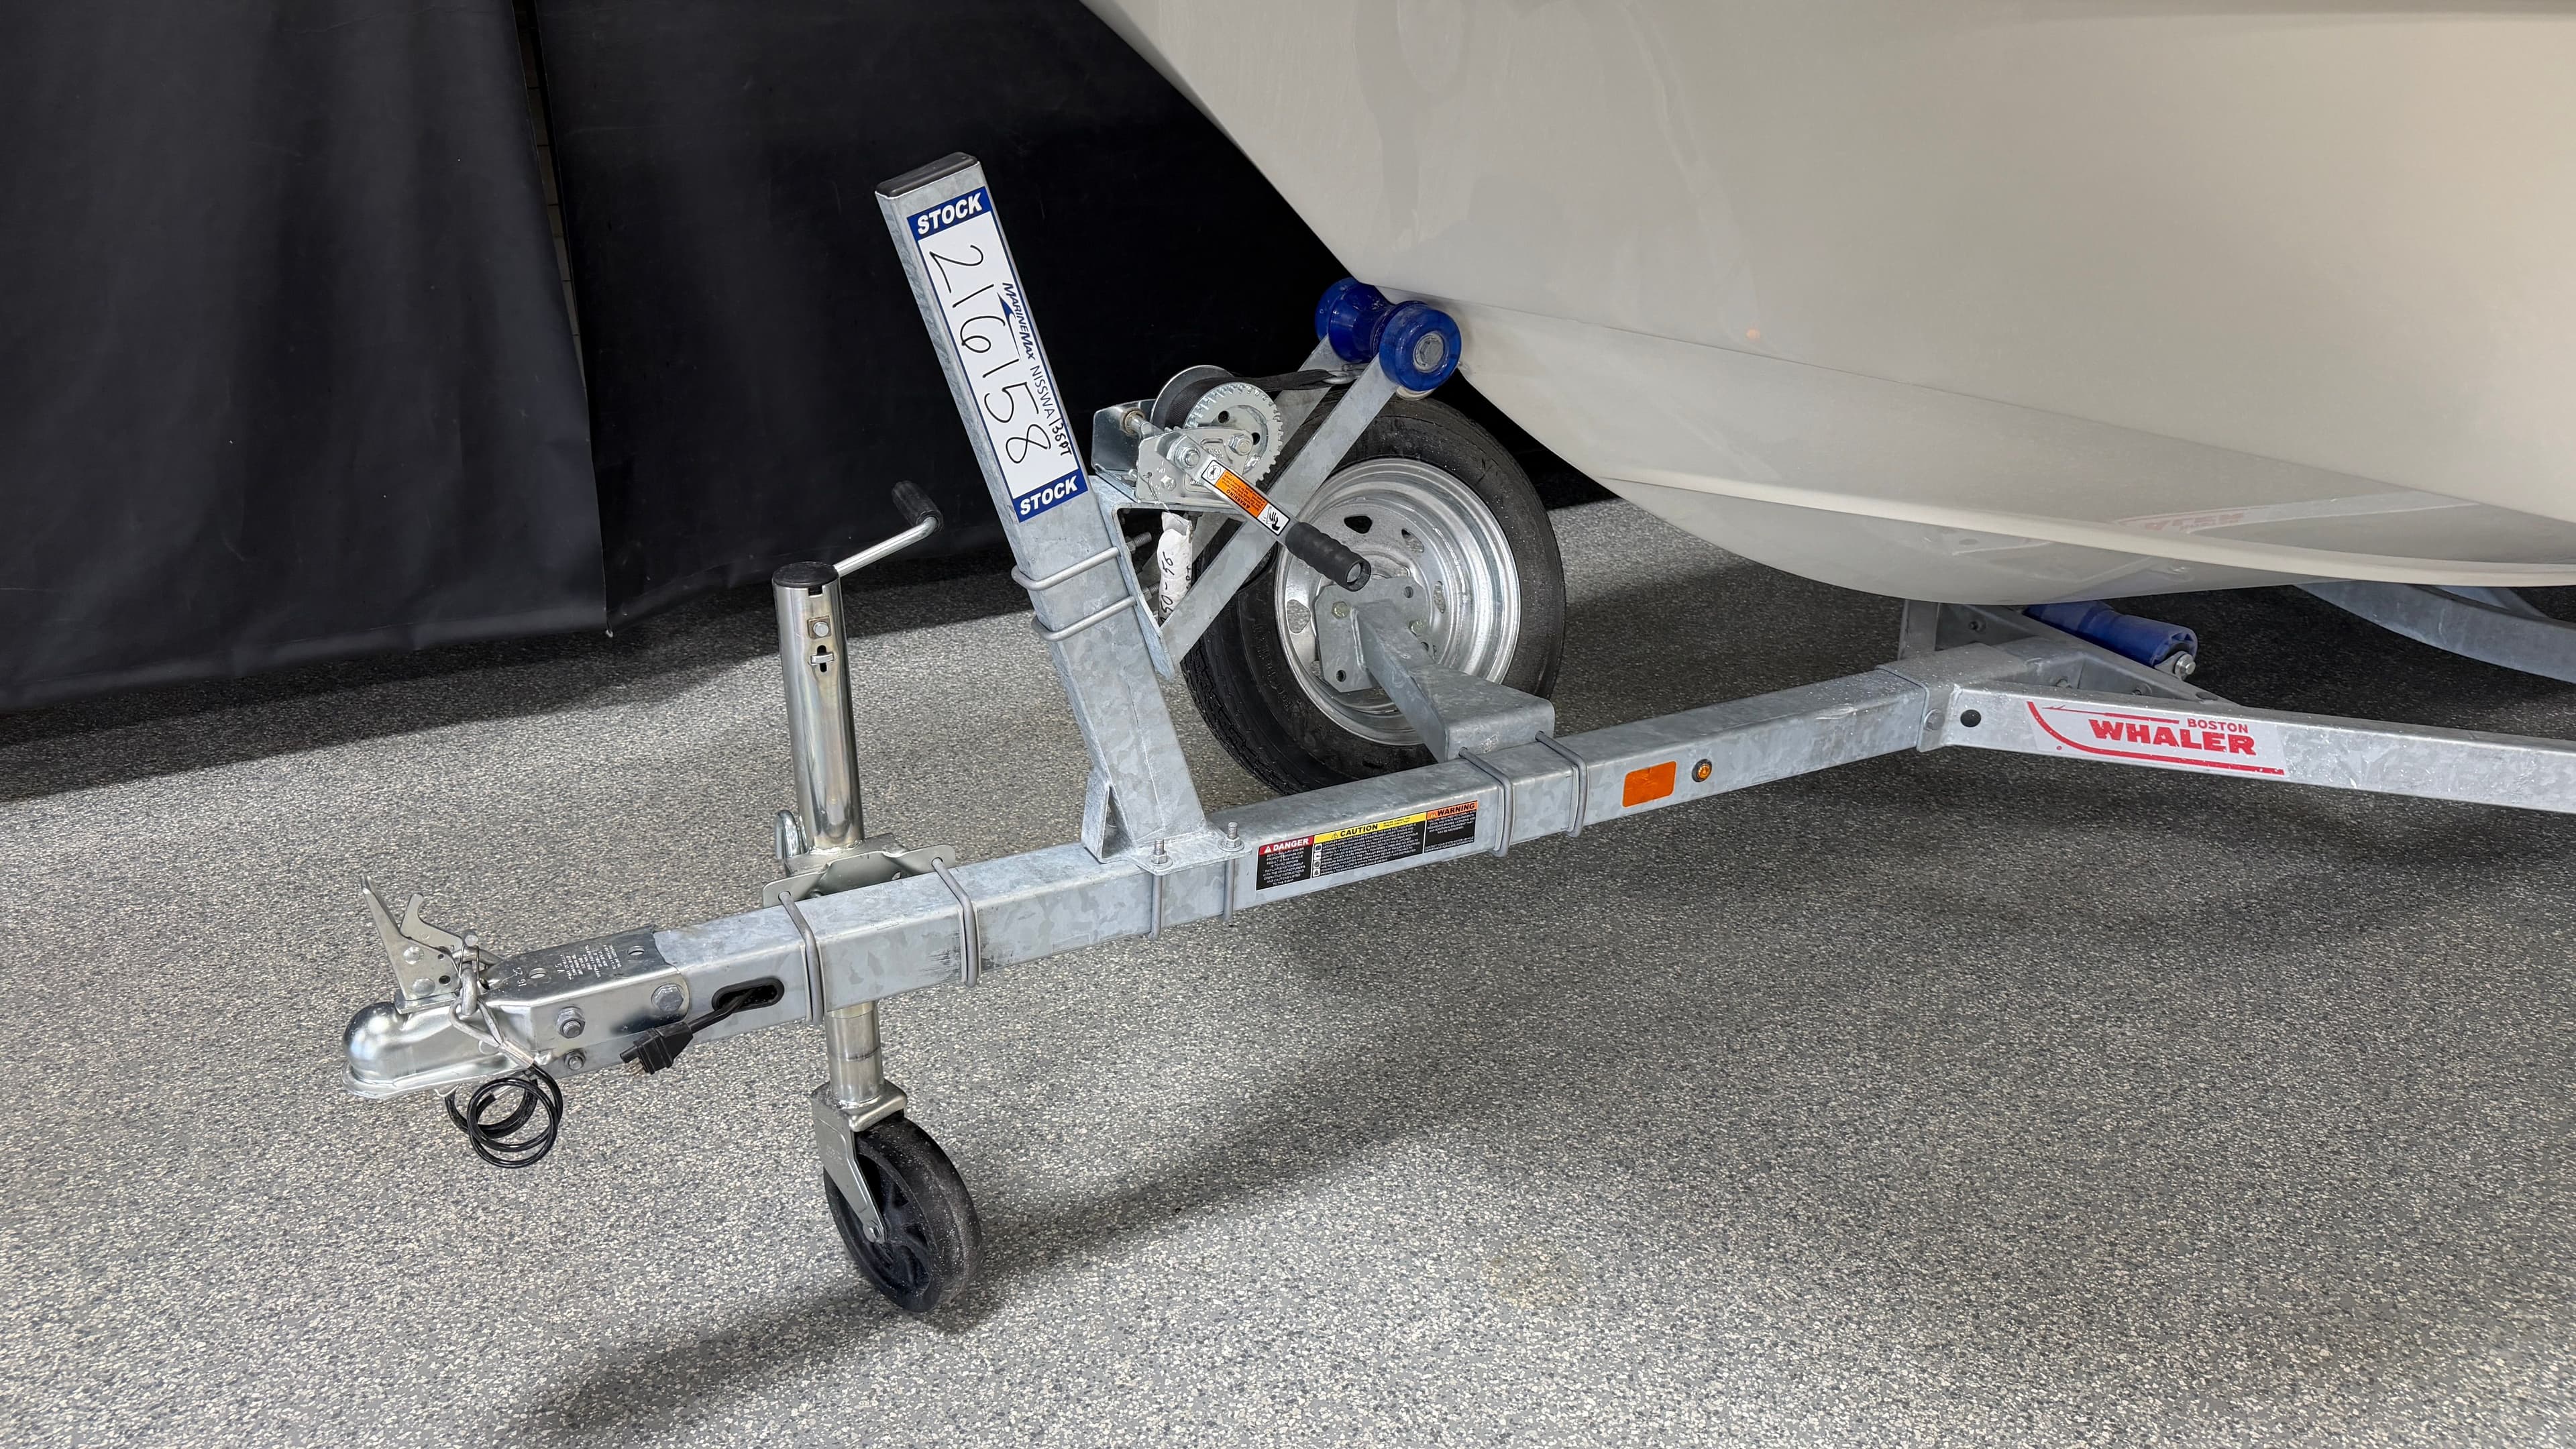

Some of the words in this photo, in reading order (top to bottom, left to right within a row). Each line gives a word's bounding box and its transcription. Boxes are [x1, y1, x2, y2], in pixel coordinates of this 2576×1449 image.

[917, 192, 982, 235] STOCK
[929, 244, 1051, 464] 216158
[1030, 365, 1055, 419] NISSWA
[1020, 476, 1077, 515] STOCK
[2088, 719, 2257, 756] WHALER
[2187, 718, 2248, 734] BOSTON
[1438, 803, 1474, 816] WARNING
[1273, 839, 1309, 851] DANGER
[1340, 824, 1378, 837] CAUTION
